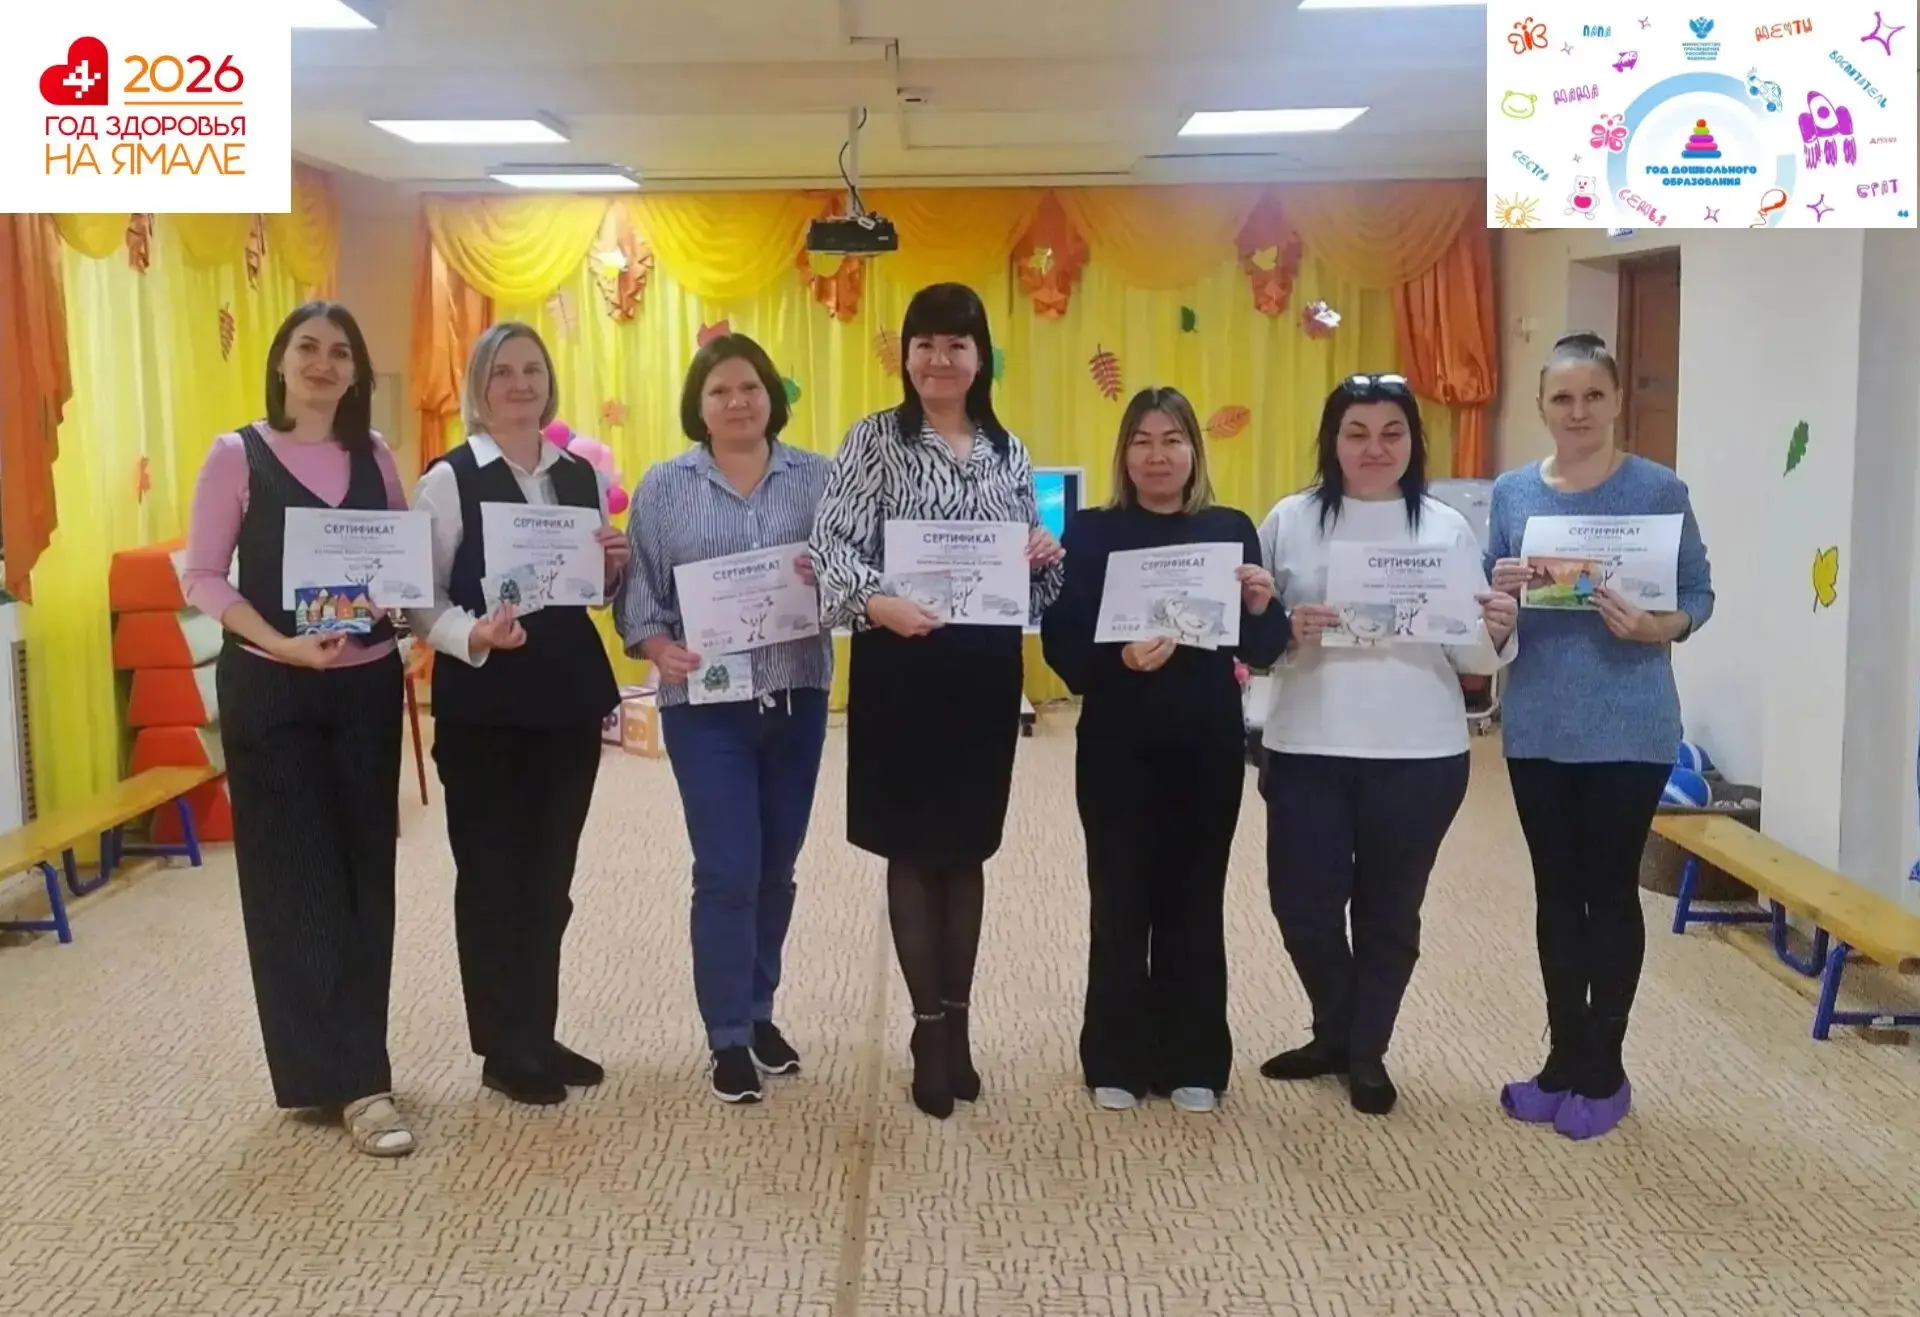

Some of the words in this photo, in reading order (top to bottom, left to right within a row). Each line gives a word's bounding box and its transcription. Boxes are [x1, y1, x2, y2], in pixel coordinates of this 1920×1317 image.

[513, 517, 575, 528] СЕРТИФИКАТ
[324, 523, 395, 534] СЕРТИФИКАТ
[1568, 527, 1640, 535] СЕРТИФИКАТ
[923, 533, 996, 544] СЕРТИФИКАТ
[1141, 557, 1206, 571] СЕРТИФИКАТ
[1368, 557, 1442, 568] СЕРТИФИКАТ
[713, 560, 780, 581] СЕРТИФИКАТ
